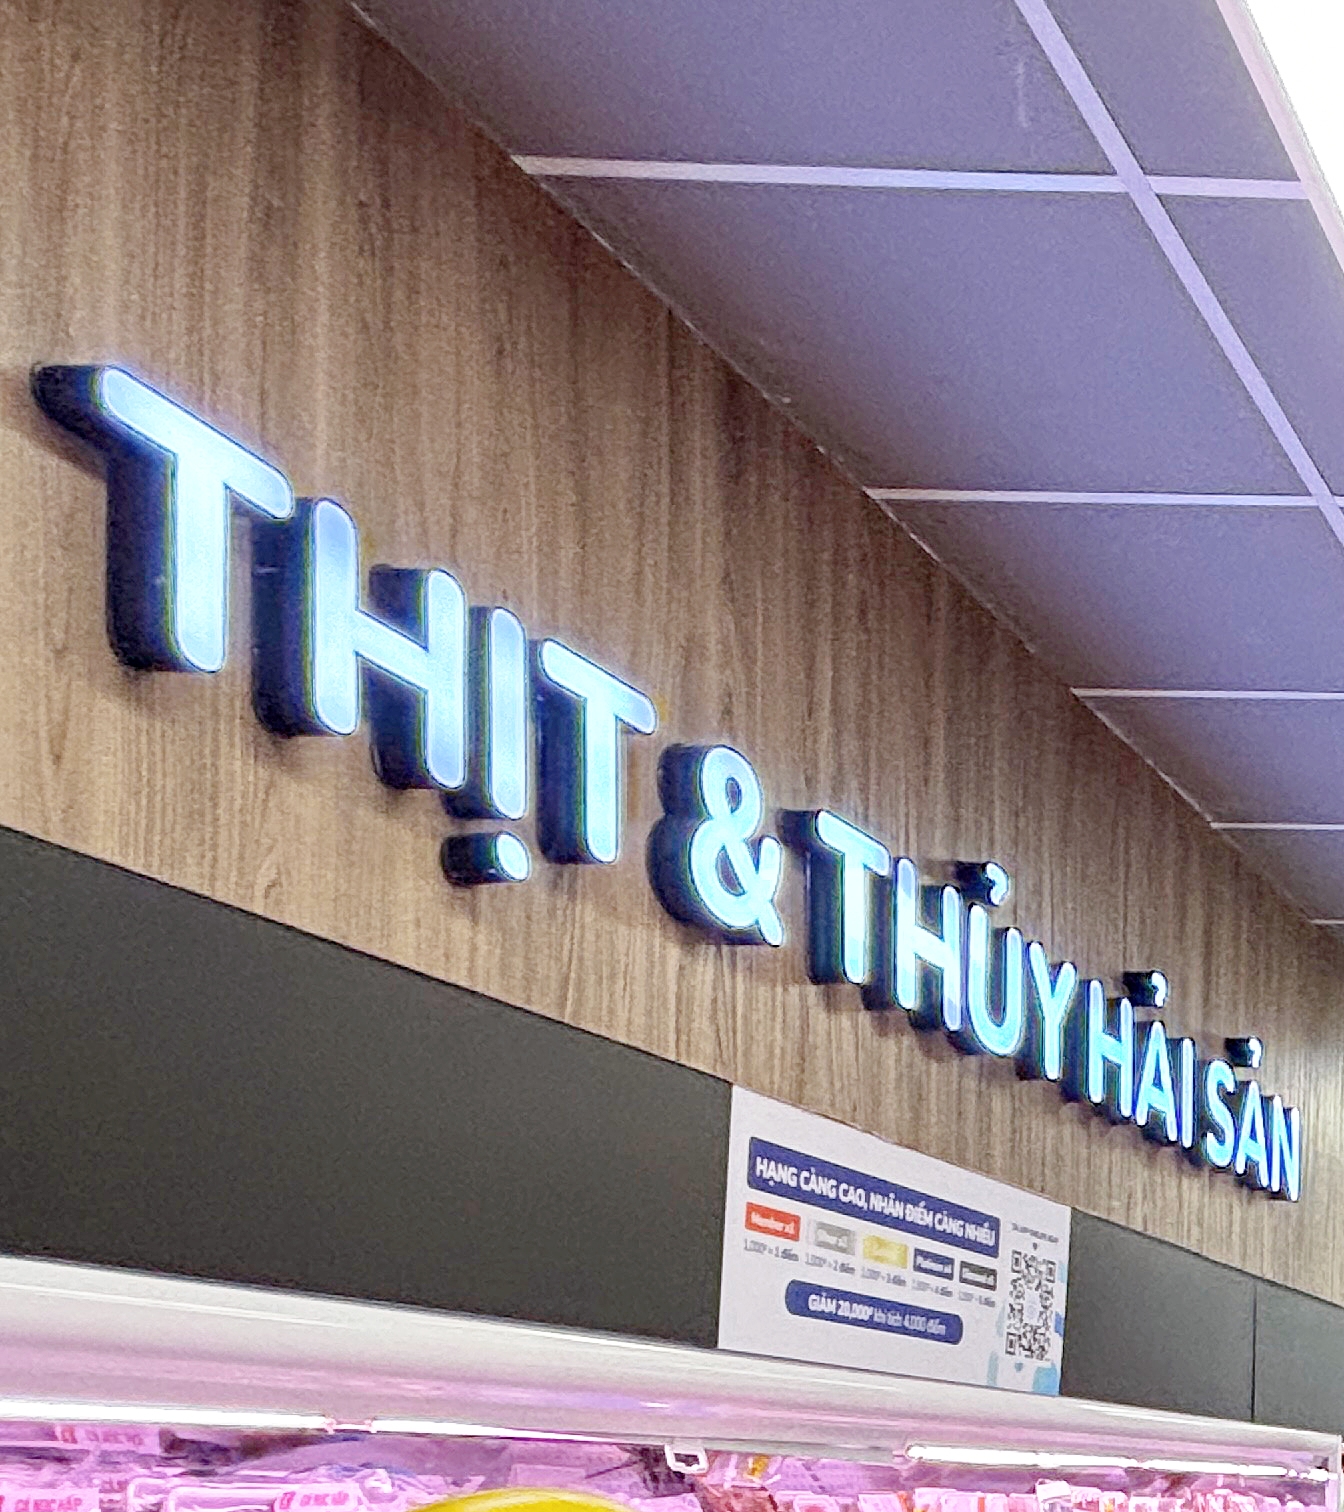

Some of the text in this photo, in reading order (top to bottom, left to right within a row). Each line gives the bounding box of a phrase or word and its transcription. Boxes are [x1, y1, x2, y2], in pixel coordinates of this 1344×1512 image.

[96, 364, 1301, 1203] THỊT & THỦY HẢI SẢN
[756, 1156, 798, 1187] HẠNG
[800, 1166, 838, 1199] CÀNG
[934, 1210, 964, 1238] CÀNG
